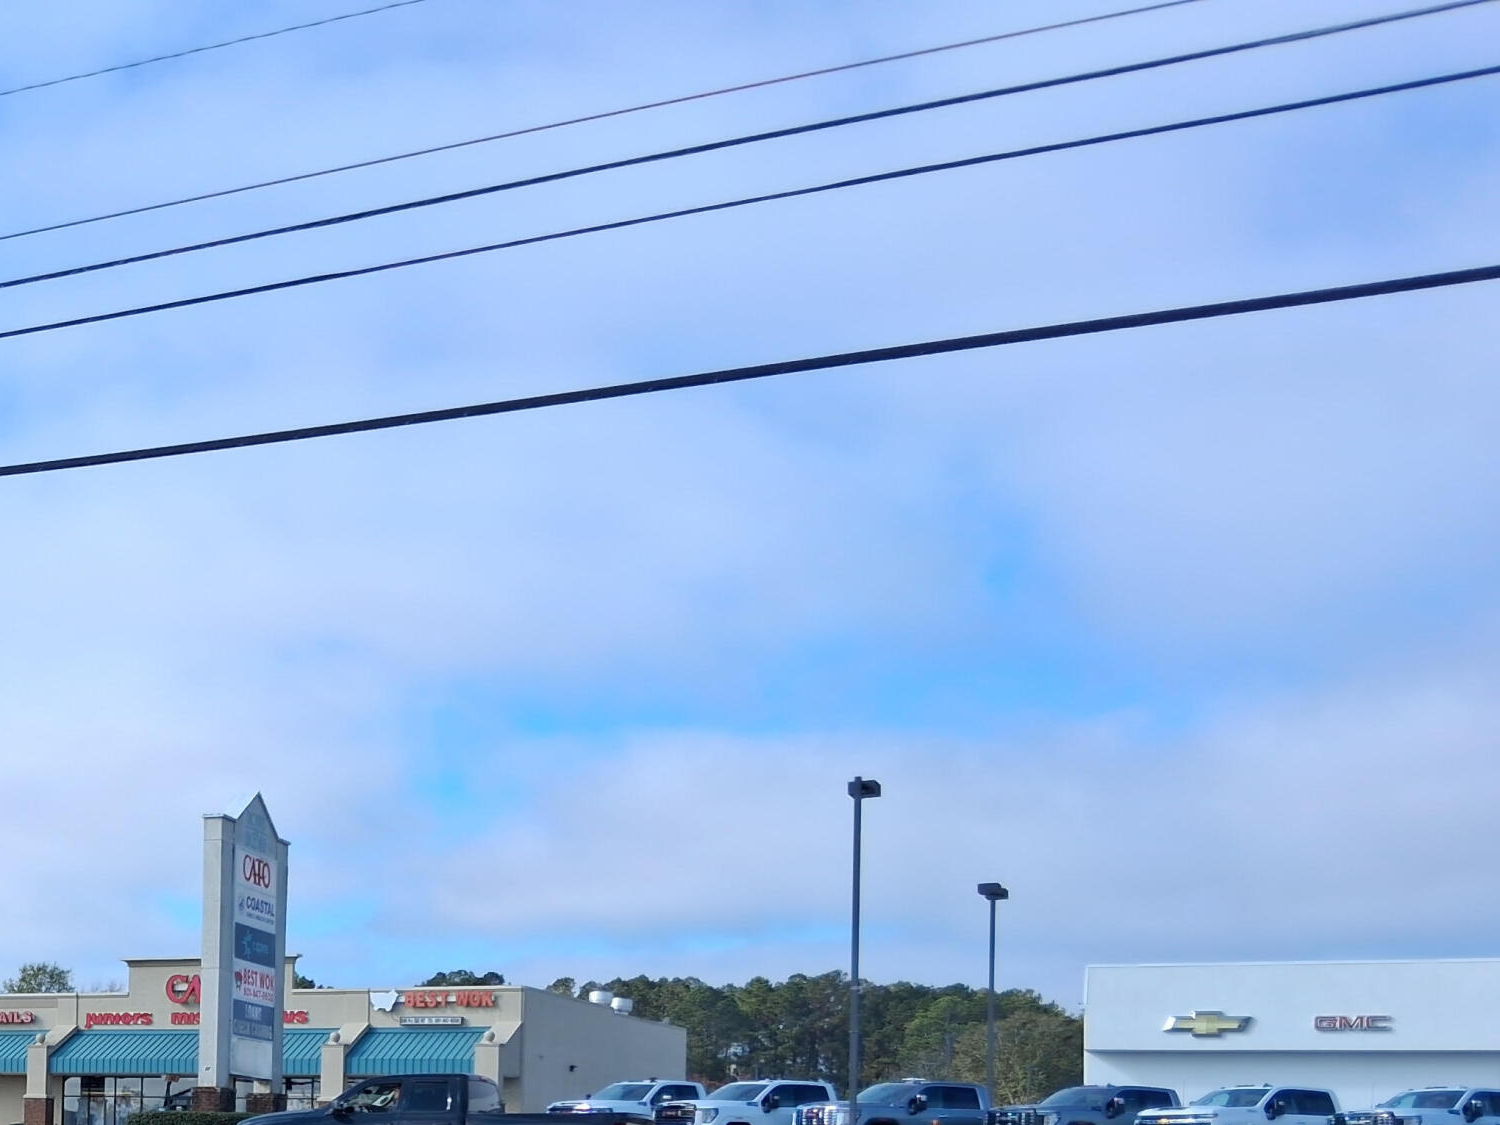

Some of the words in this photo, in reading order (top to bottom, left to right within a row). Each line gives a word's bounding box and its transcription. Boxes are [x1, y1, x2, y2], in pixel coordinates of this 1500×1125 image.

[243, 854, 270, 888] CATO
[246, 896, 275, 917] COASTAL
[165, 974, 201, 1004] CA
[243, 968, 258, 987] BEST
[259, 973, 275, 991] WOK
[404, 991, 449, 1008] BEST
[455, 990, 494, 1008] WOK
[85, 1012, 152, 1028] juniors
[171, 1012, 200, 1025] mis
[283, 1010, 308, 1024] us
[1314, 1016, 1392, 1032] GMC
